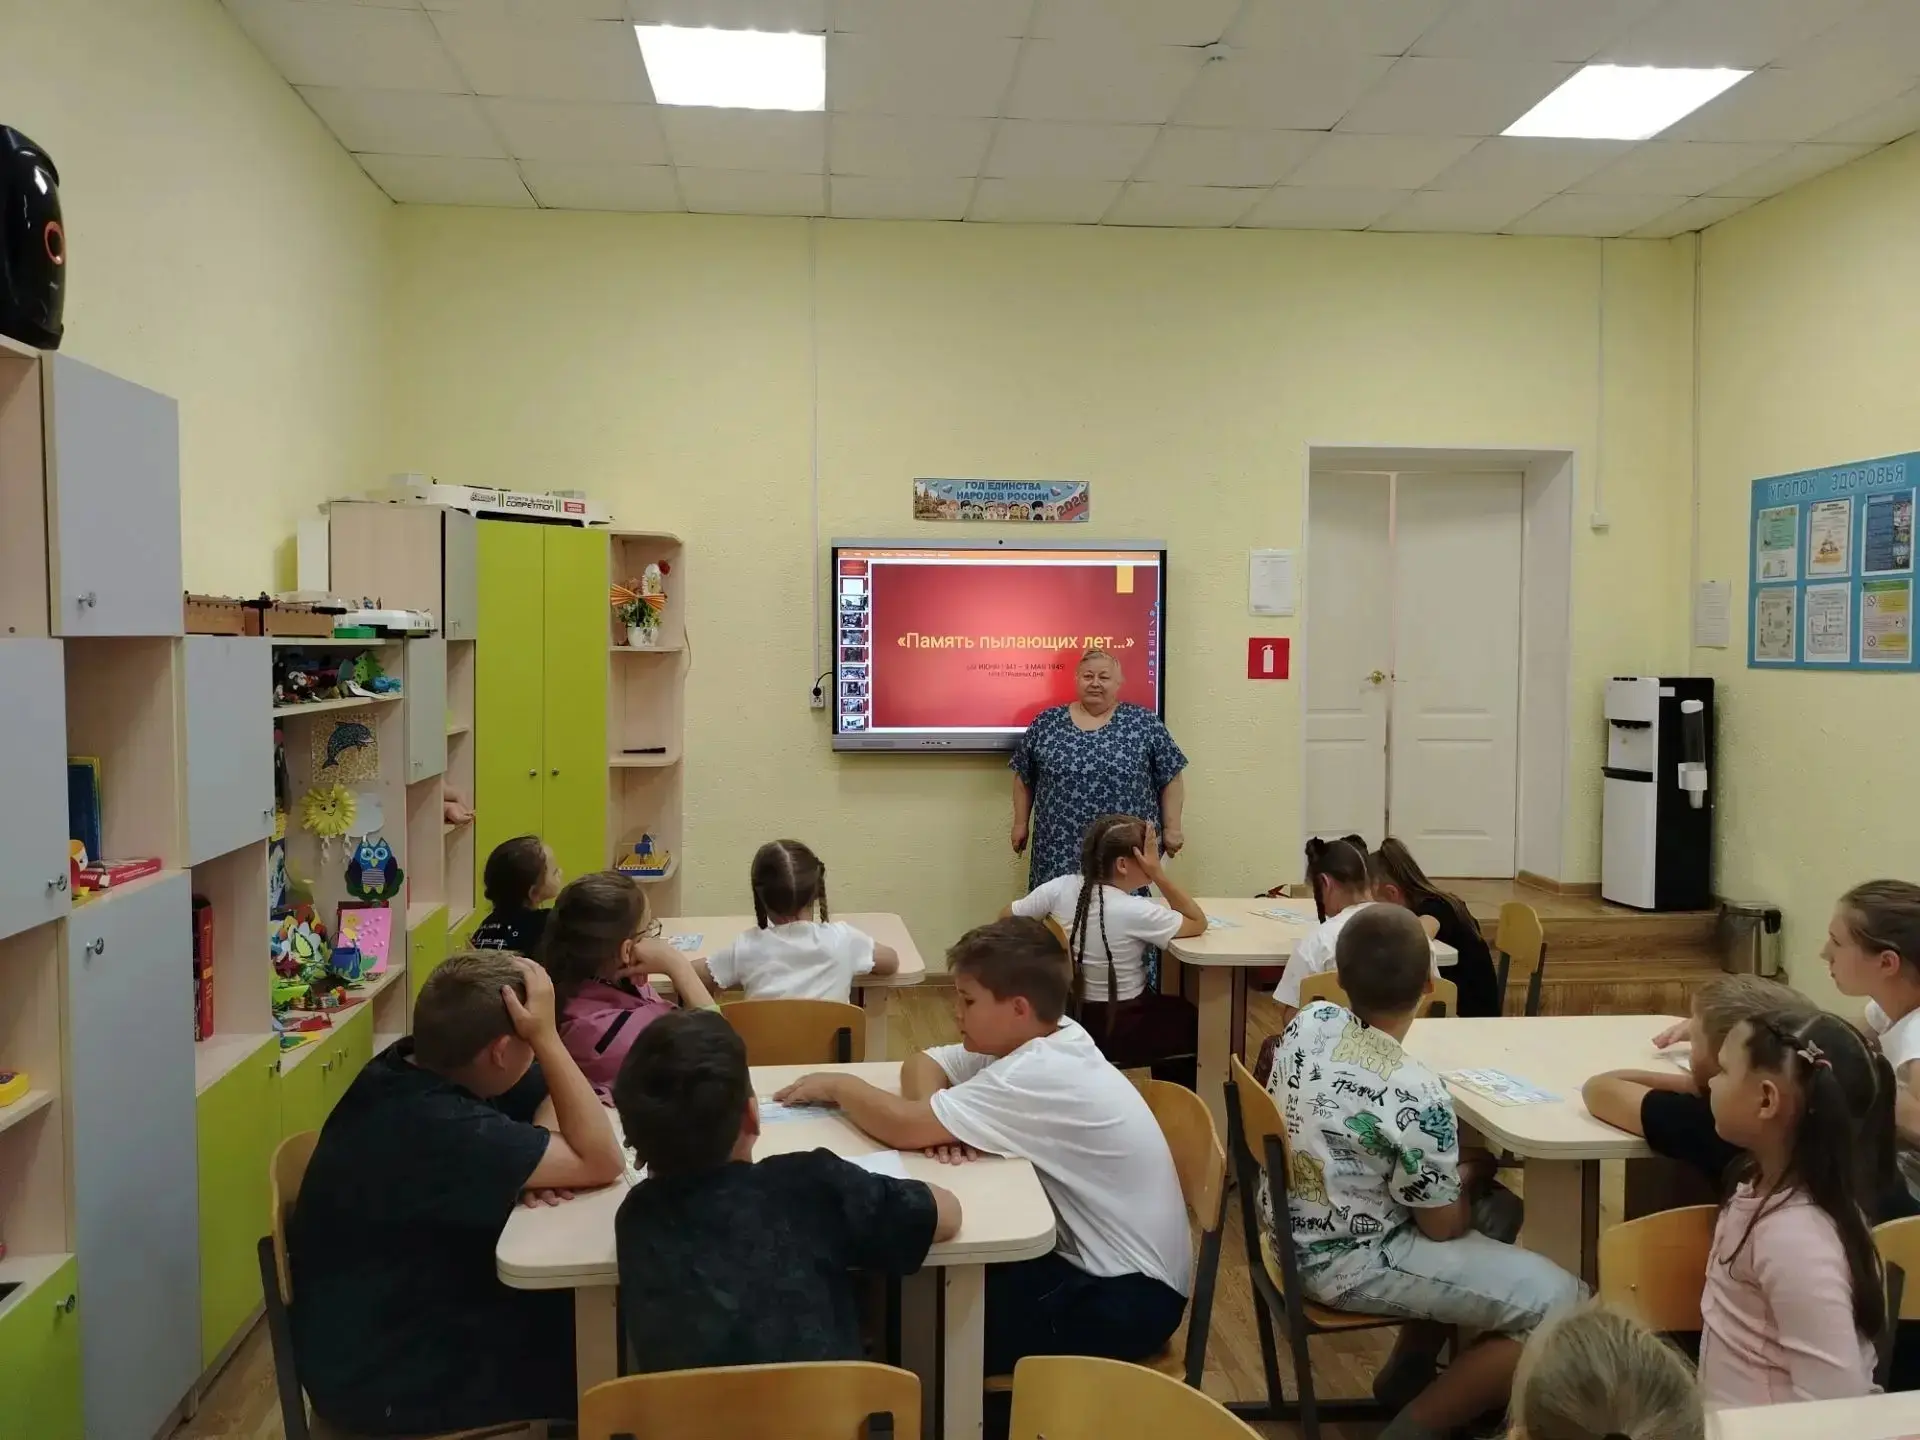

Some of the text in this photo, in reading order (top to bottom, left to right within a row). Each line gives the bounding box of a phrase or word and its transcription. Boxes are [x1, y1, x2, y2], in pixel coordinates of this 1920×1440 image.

[965, 481, 1041, 491] ГОД ЕДИНСТВА
[1831, 463, 1905, 491] ЗДОРОВЬЯ
[505, 500, 555, 511] COMPETITION
[956, 491, 1049, 501] НАРОДОВ РОССИИ
[1057, 492, 1088, 516] 2026
[897, 632, 974, 649] «Память
[980, 636, 1078, 651] пылающих
[1291, 1210, 1336, 1232] YOURSEL
